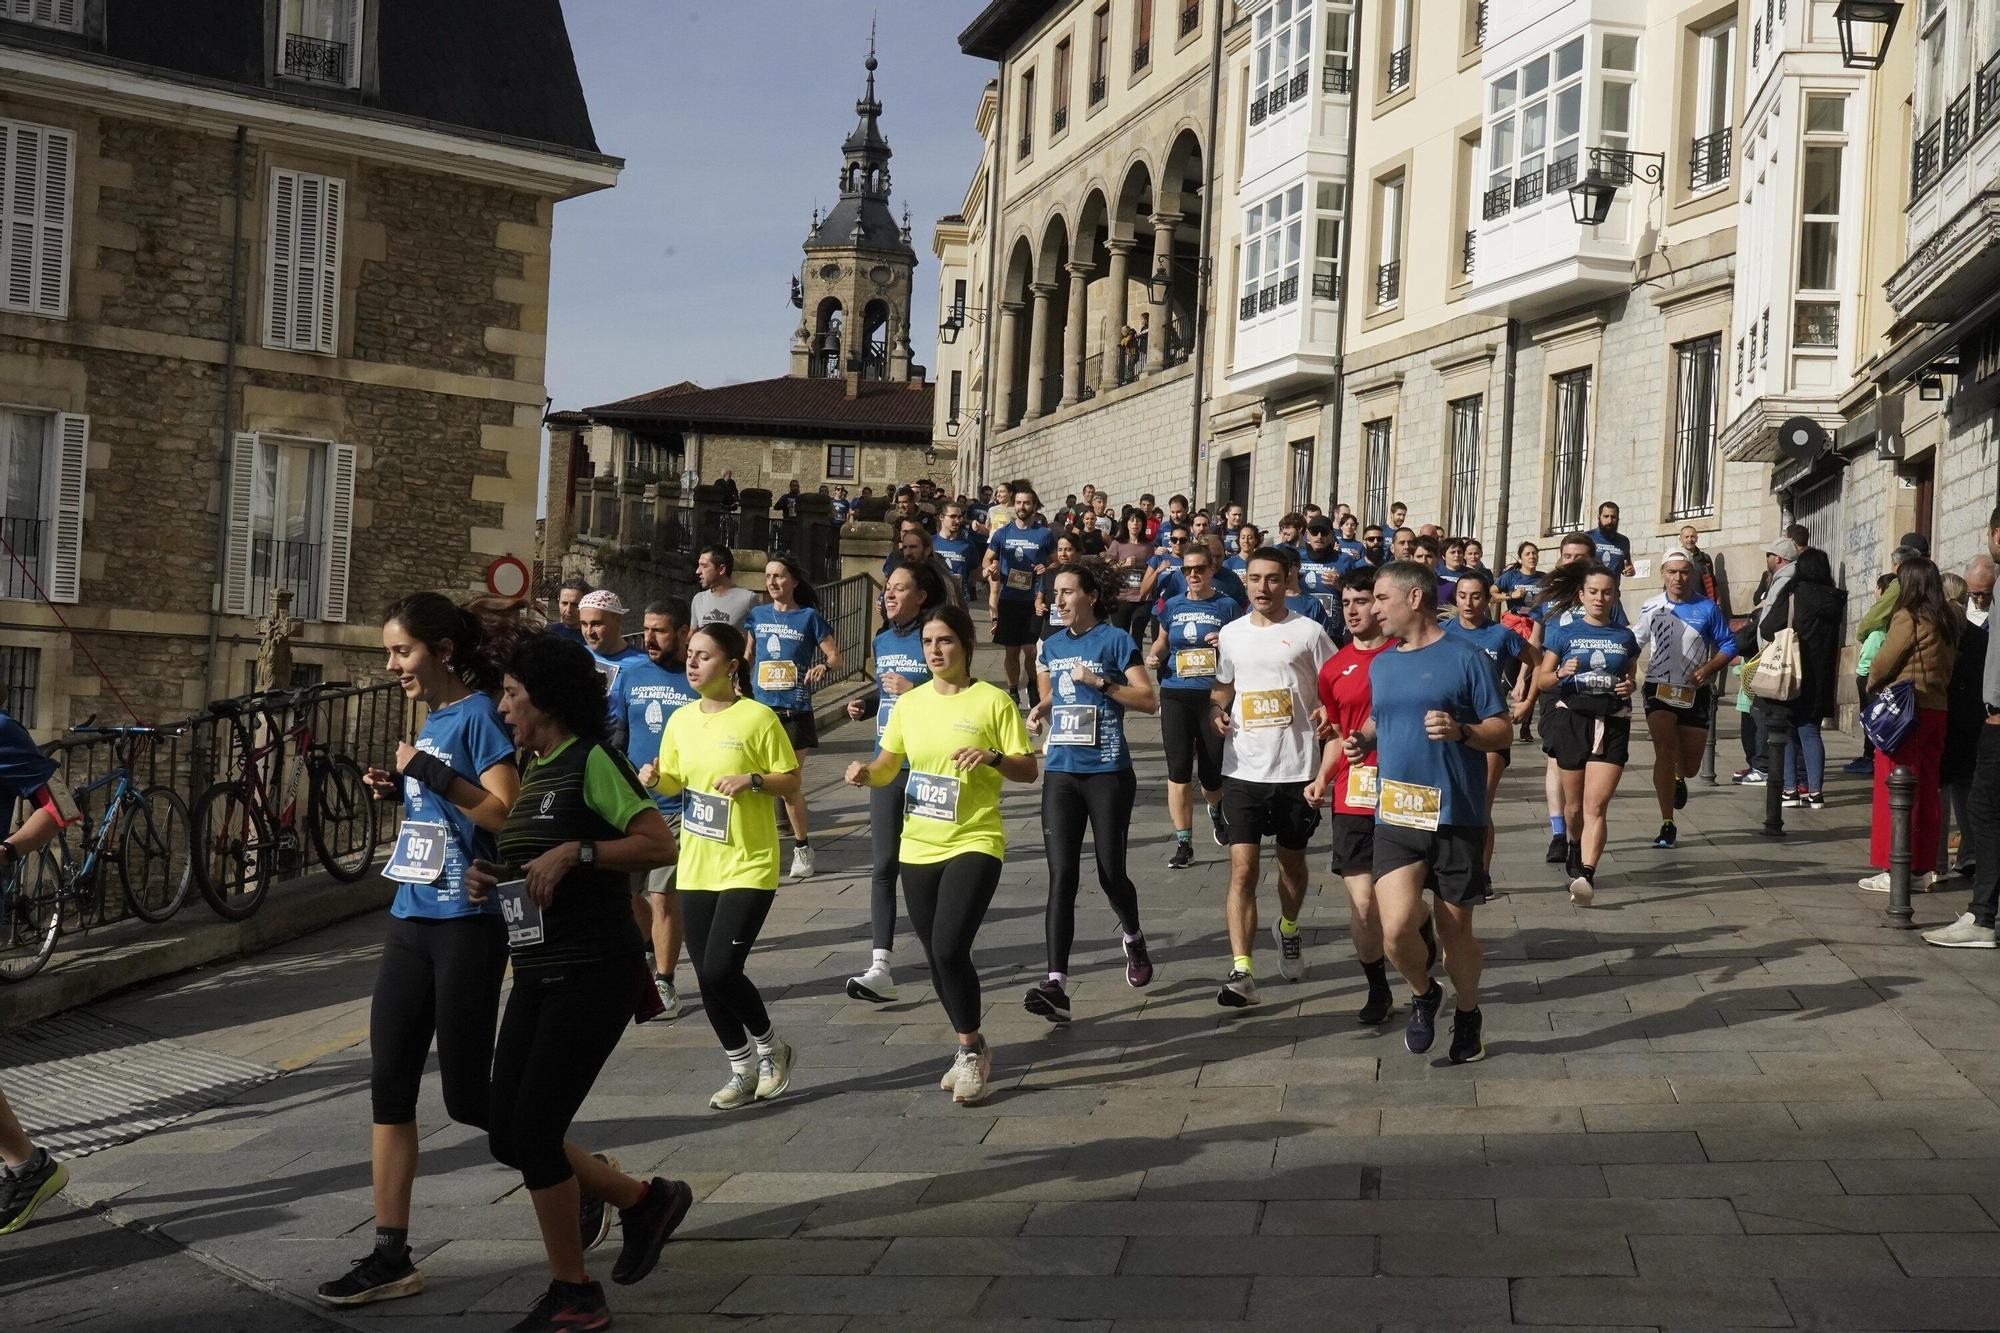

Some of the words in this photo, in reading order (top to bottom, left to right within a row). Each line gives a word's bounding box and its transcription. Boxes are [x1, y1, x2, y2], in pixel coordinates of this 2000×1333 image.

[1905, 478, 1911, 488] 2
[769, 668, 786, 679] 287
[1585, 675, 1612, 689] 1058
[638, 691, 688, 702] ALMENDRA
[1671, 687, 1682, 697] 31
[1253, 698, 1279, 715] 349
[1061, 715, 1079, 730] 971
[916, 783, 948, 805] 1025
[1394, 792, 1424, 812] 348
[692, 801, 714, 823] 750
[406, 836, 433, 860] 957
[500, 896, 524, 923] 64
